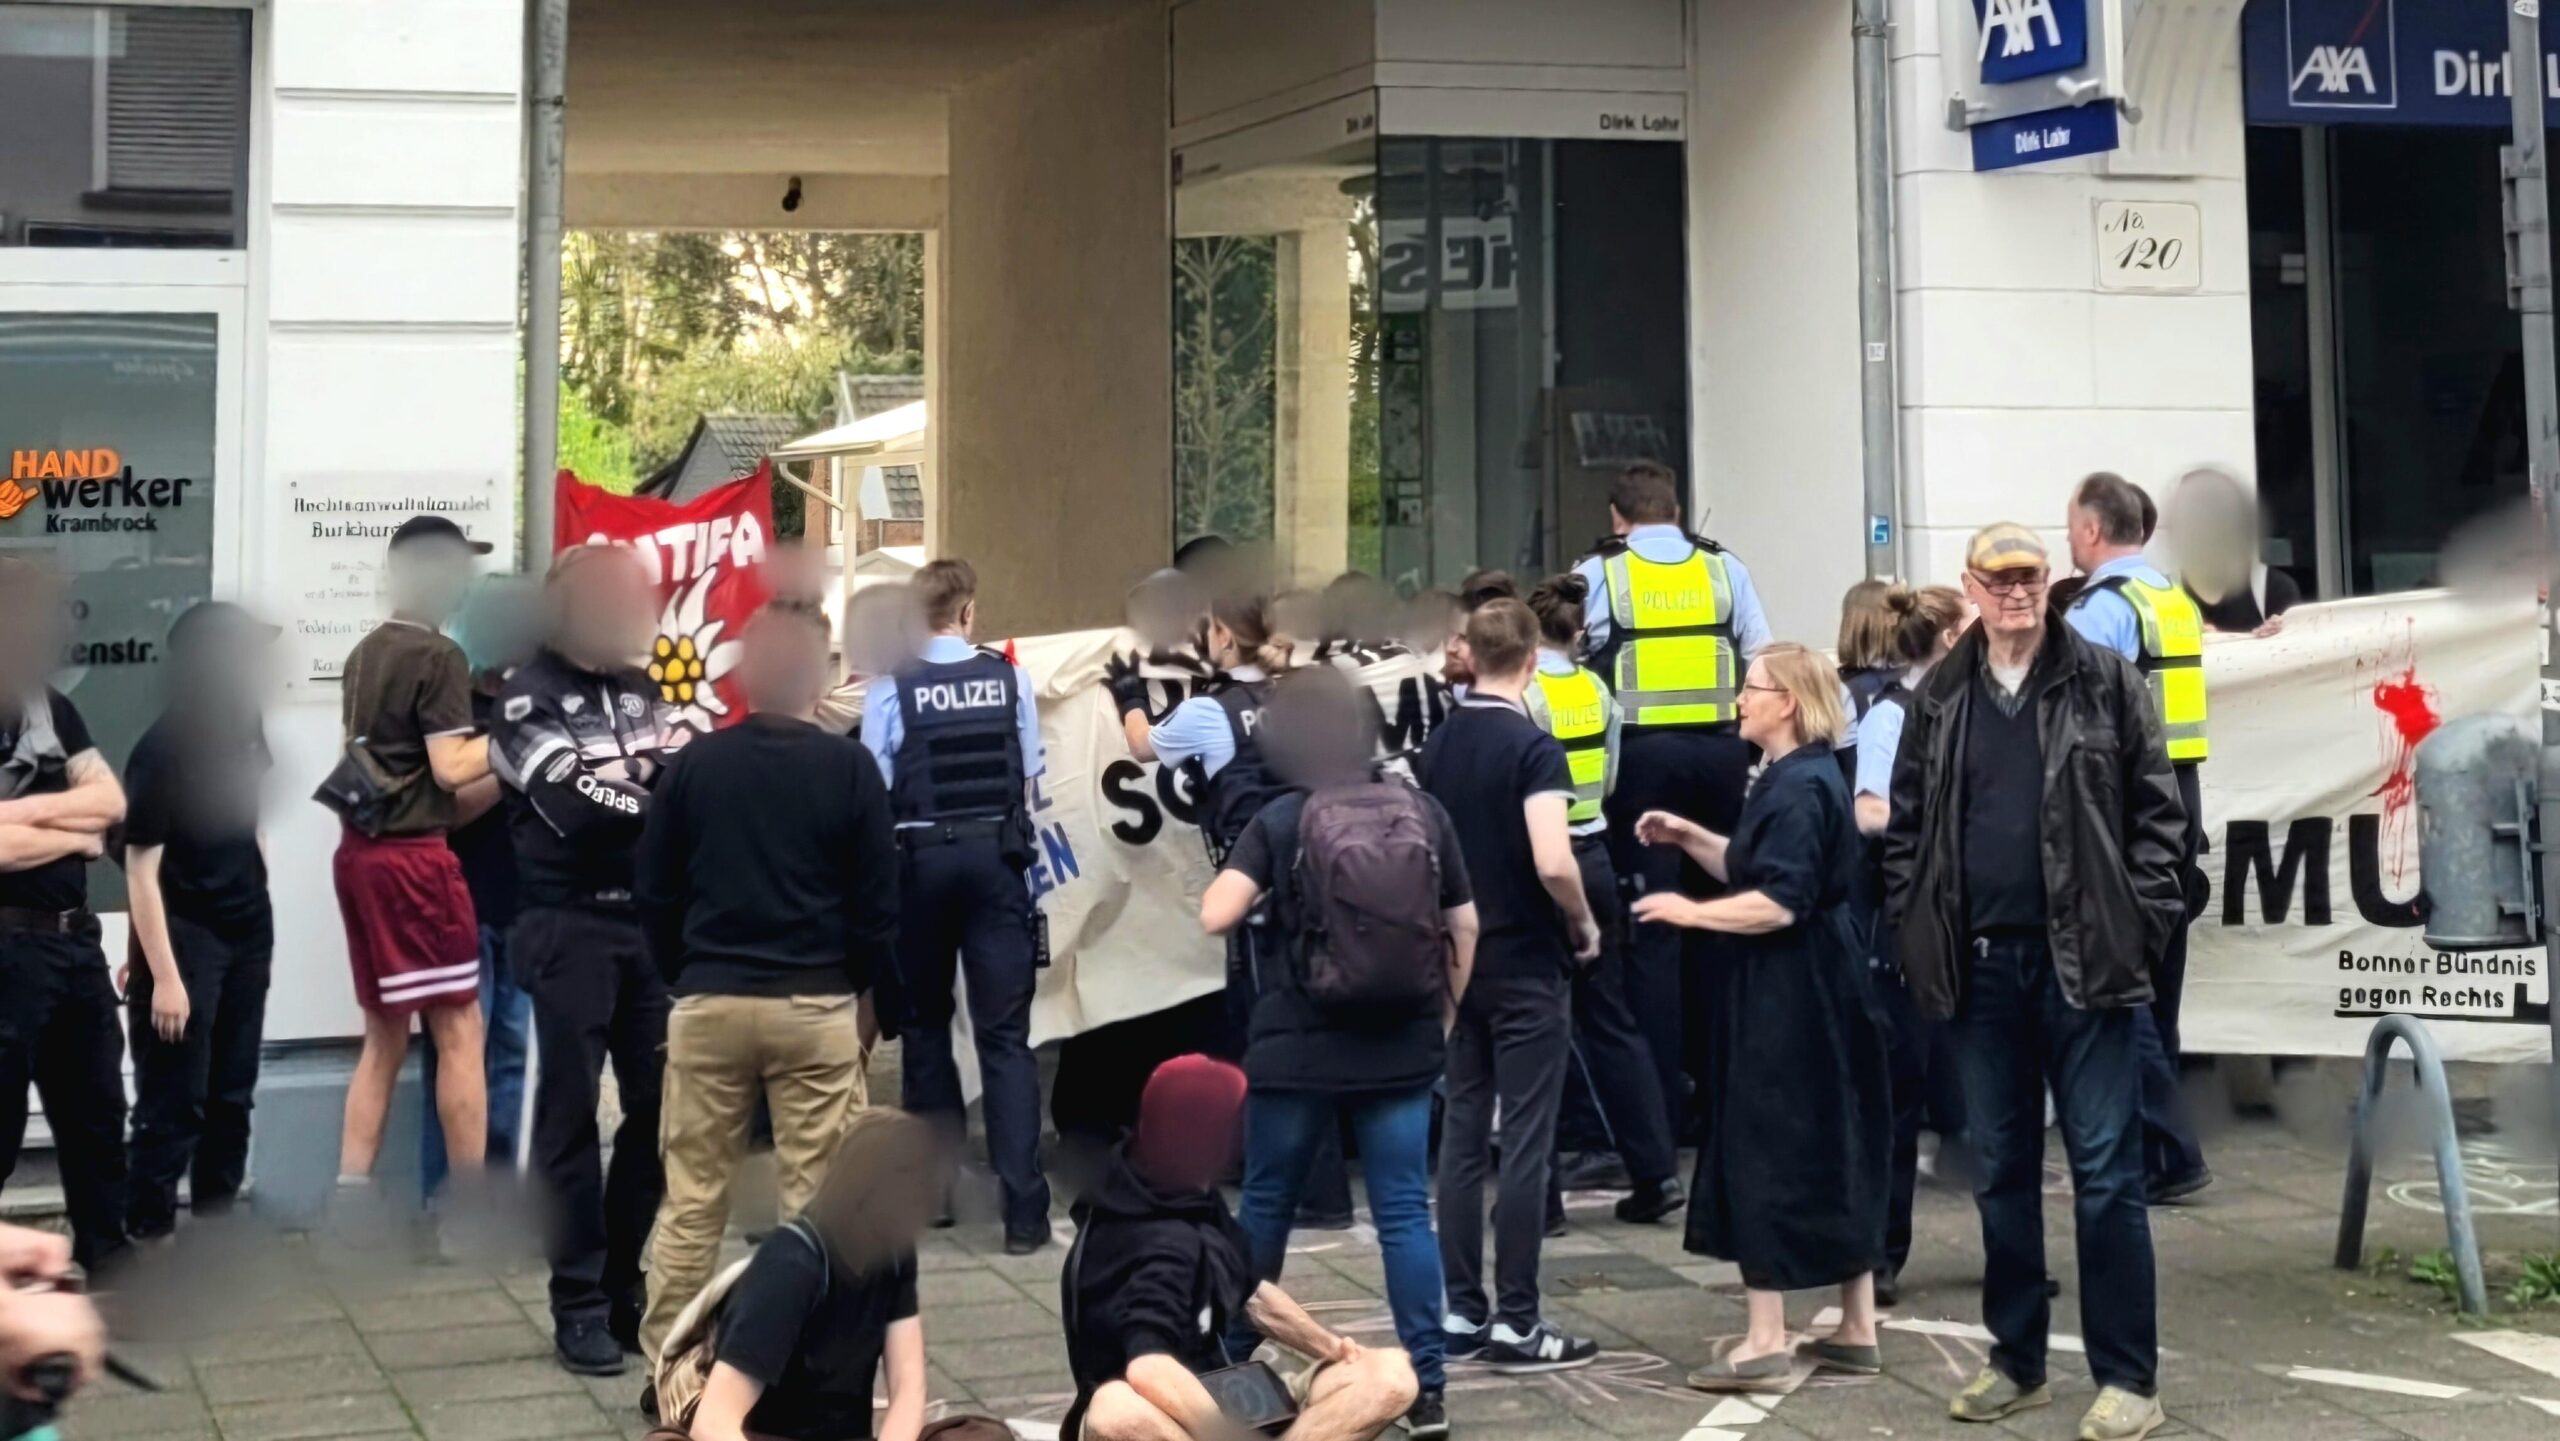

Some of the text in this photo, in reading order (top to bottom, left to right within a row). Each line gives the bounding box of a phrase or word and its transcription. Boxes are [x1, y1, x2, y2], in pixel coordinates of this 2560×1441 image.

[1977, 0, 2062, 64] AXA
[2291, 46, 2376, 93] AXA
[1599, 113, 1635, 130] Dirk
[2114, 237, 2183, 270] 120
[12, 449, 120, 478] HAND
[41, 465, 192, 509] werker
[46, 512, 157, 532] Krambrock
[914, 679, 1007, 714] POLIZEI
[576, 775, 640, 814] SPEED
